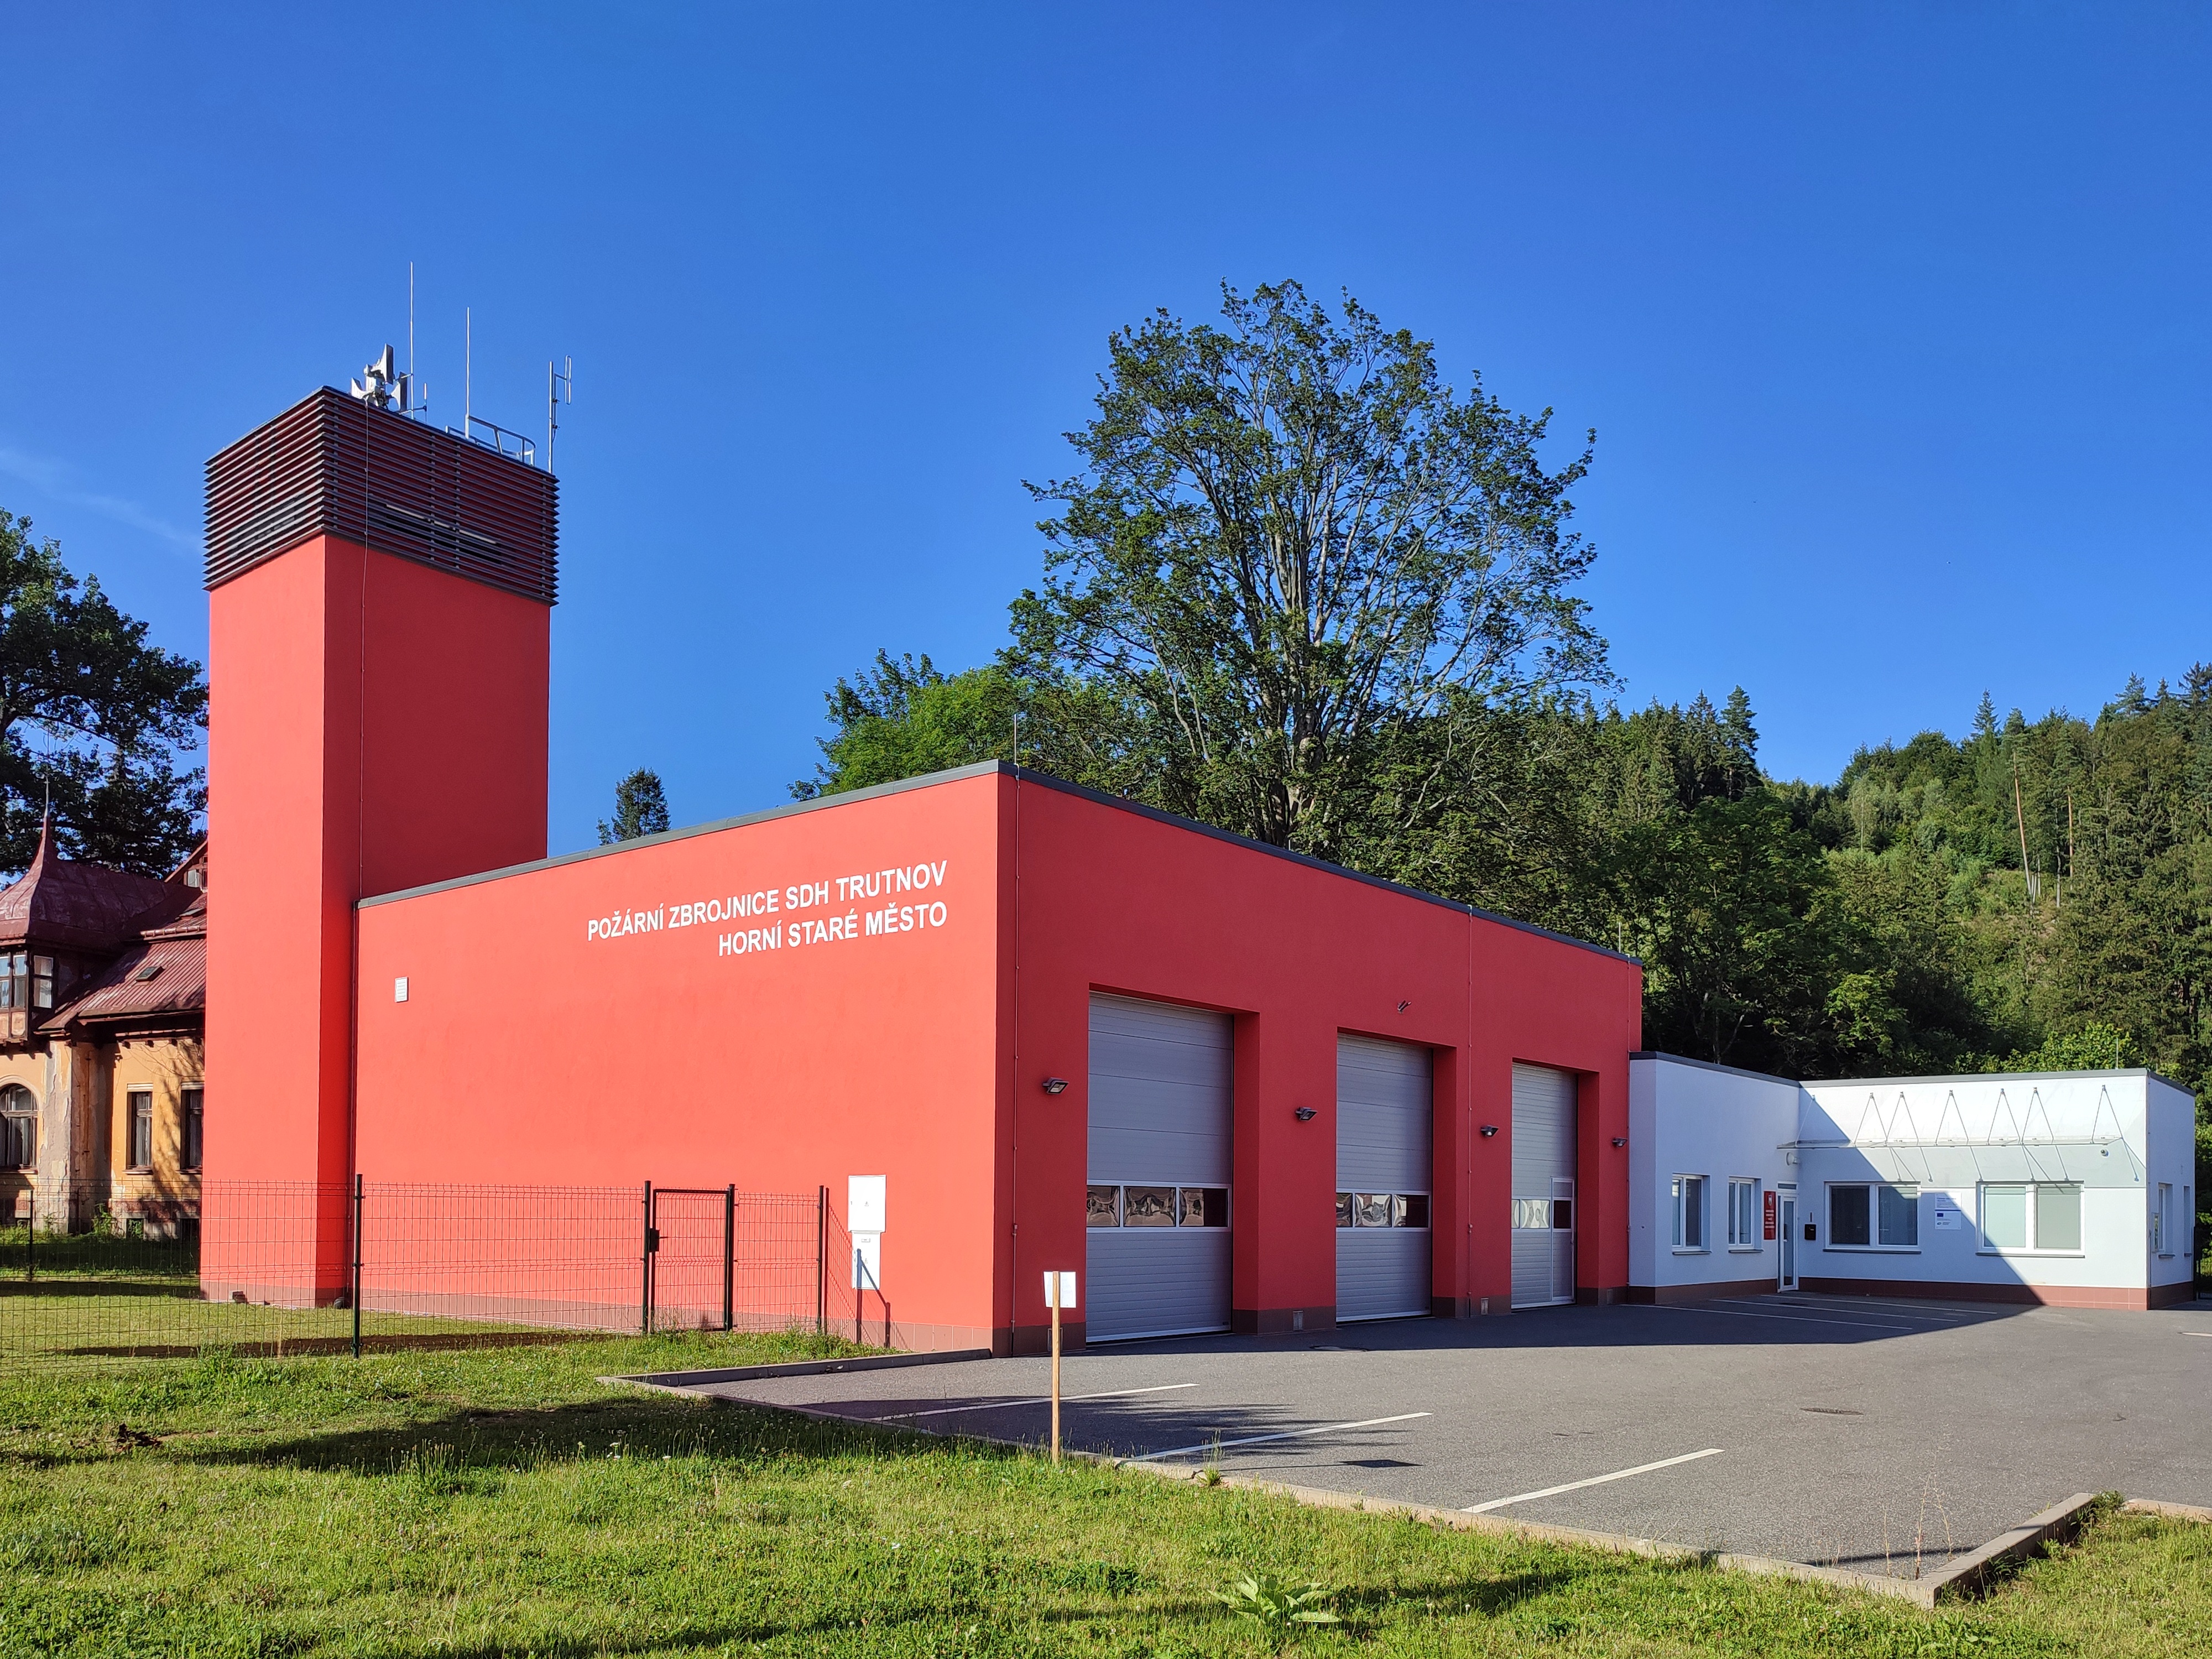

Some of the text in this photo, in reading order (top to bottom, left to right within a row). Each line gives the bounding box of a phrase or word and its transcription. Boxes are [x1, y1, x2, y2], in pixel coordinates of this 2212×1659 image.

[588, 860, 947, 941] POŽÁRNÍ ZBROJNICE SDH TRUTNOV
[719, 901, 947, 957] HORNÍ STARÉ MĚSTO
